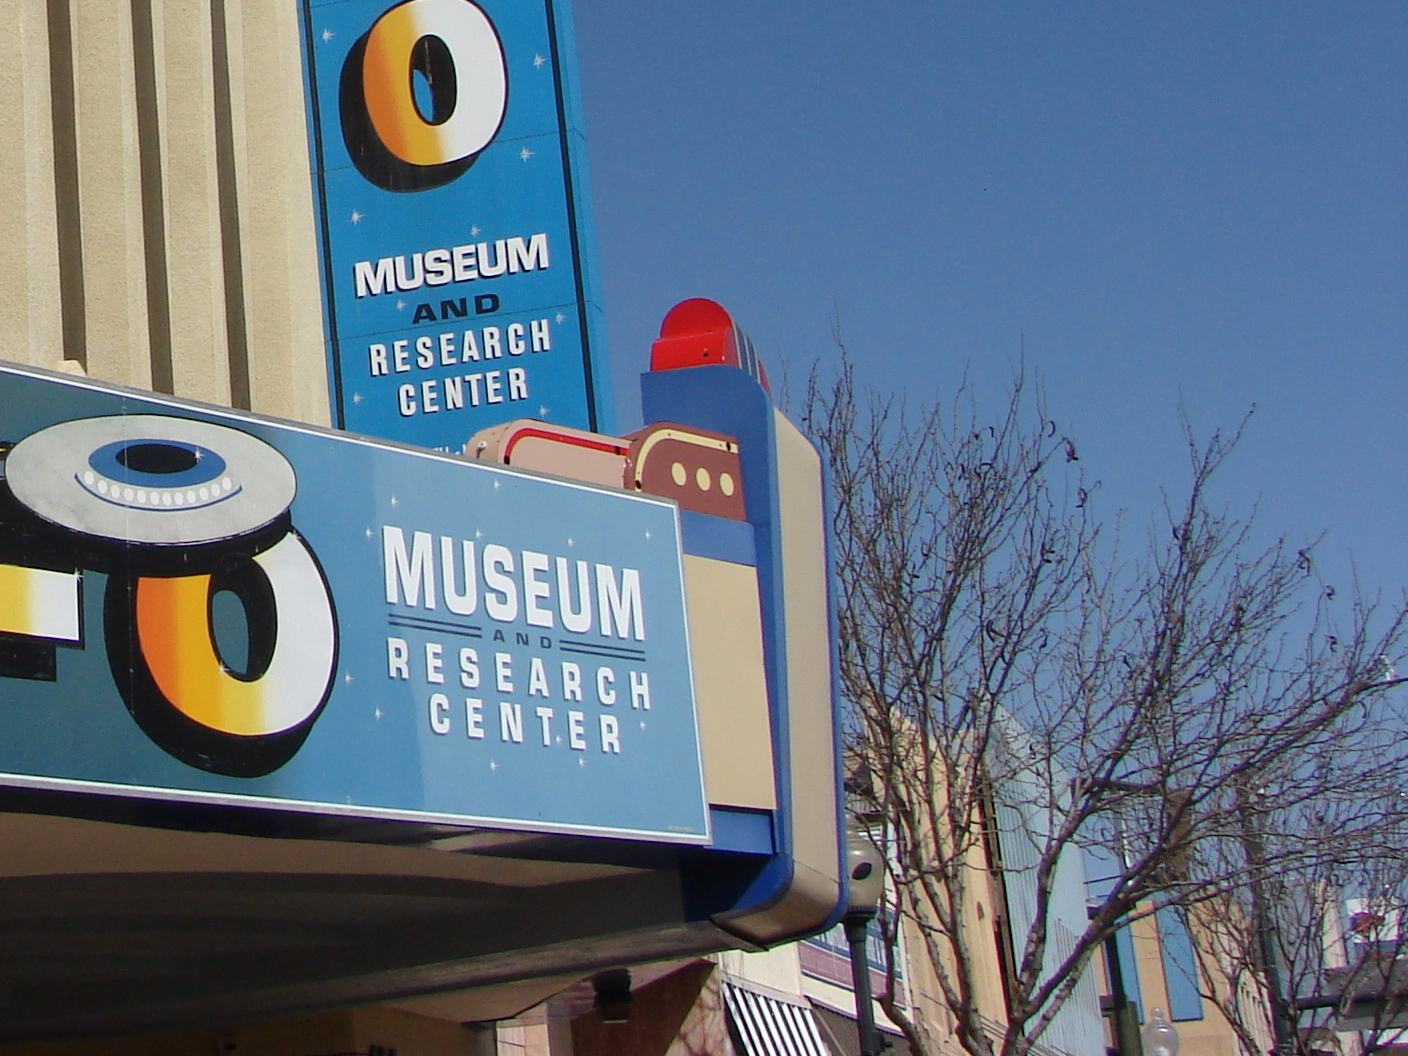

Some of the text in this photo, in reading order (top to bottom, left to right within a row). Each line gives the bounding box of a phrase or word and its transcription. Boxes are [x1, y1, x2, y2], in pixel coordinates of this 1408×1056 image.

[354, 232, 550, 298] MUSEUM
[412, 294, 500, 324] AND
[369, 319, 551, 376] RESEARCH
[398, 367, 528, 417] CENTER
[383, 525, 645, 641] MUSEUM
[493, 629, 552, 649] AND
[387, 637, 651, 710] RESEARCH
[429, 693, 620, 754] CENTER
